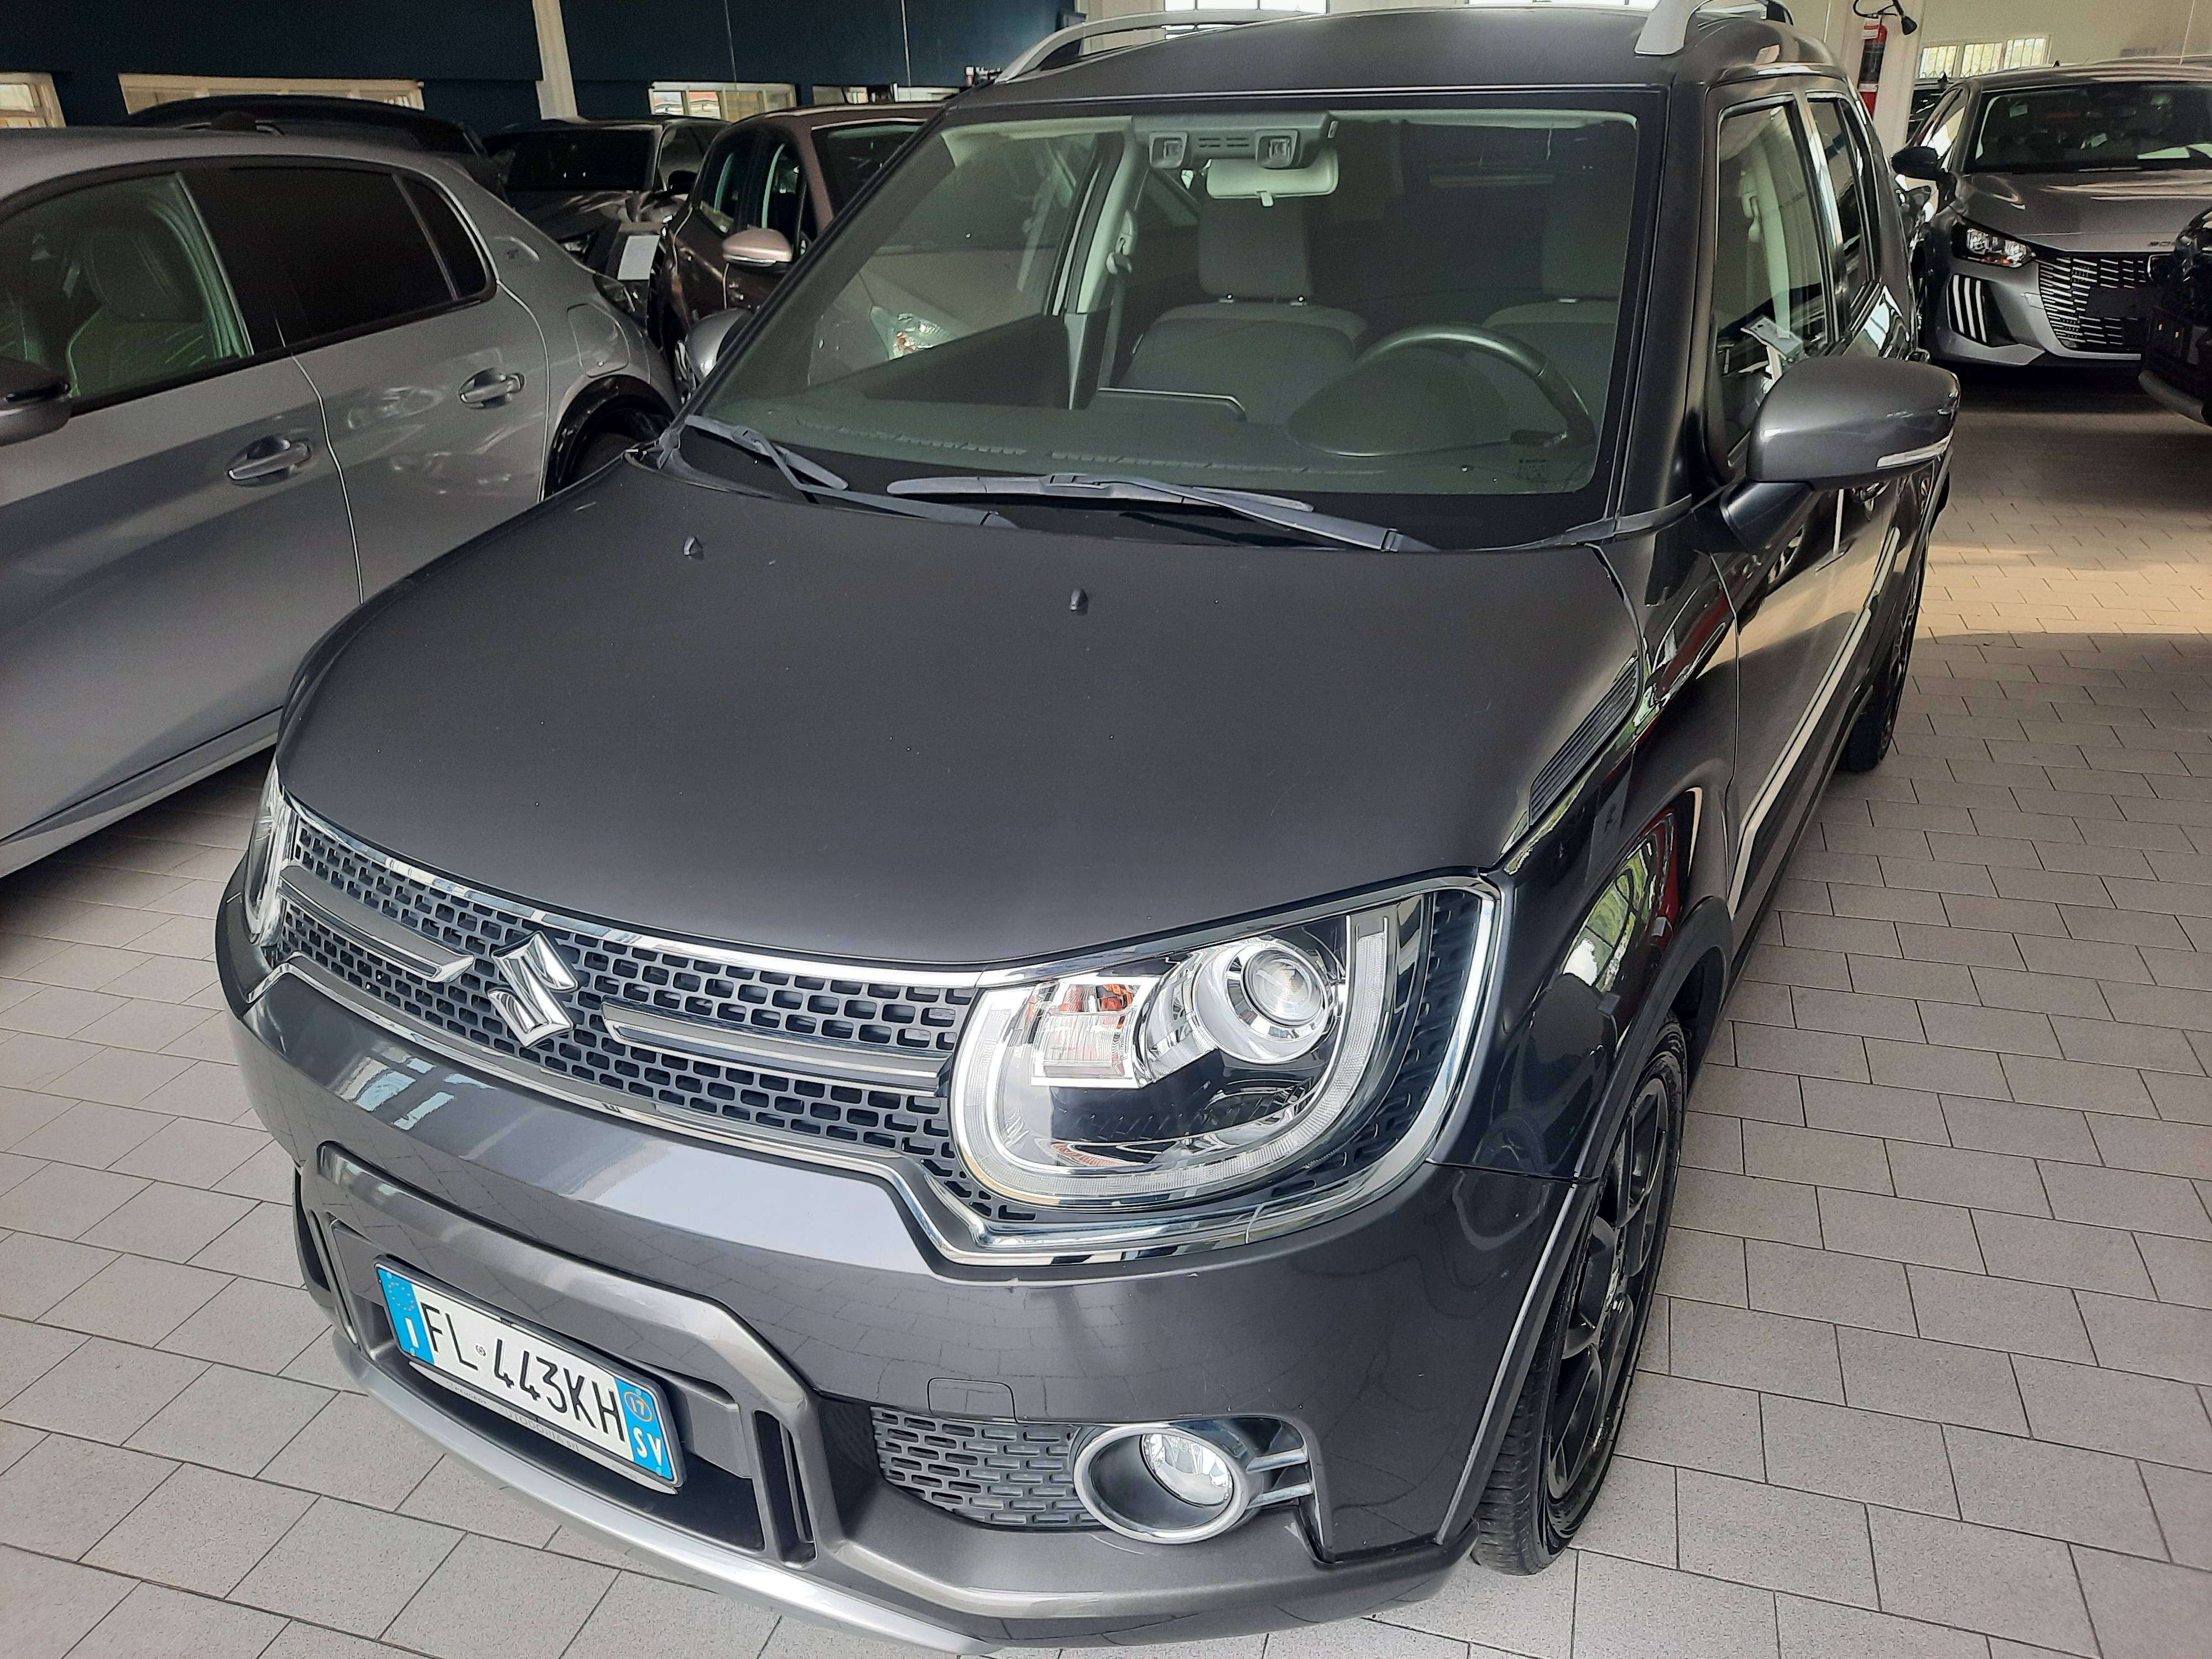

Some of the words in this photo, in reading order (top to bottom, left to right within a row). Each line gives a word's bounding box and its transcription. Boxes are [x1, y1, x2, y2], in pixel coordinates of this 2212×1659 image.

[405, 1317, 419, 1348] I
[420, 1302, 478, 1370] FL
[494, 1338, 625, 1442] 443KH
[630, 1397, 645, 1416] 17
[633, 1427, 662, 1466] SV
